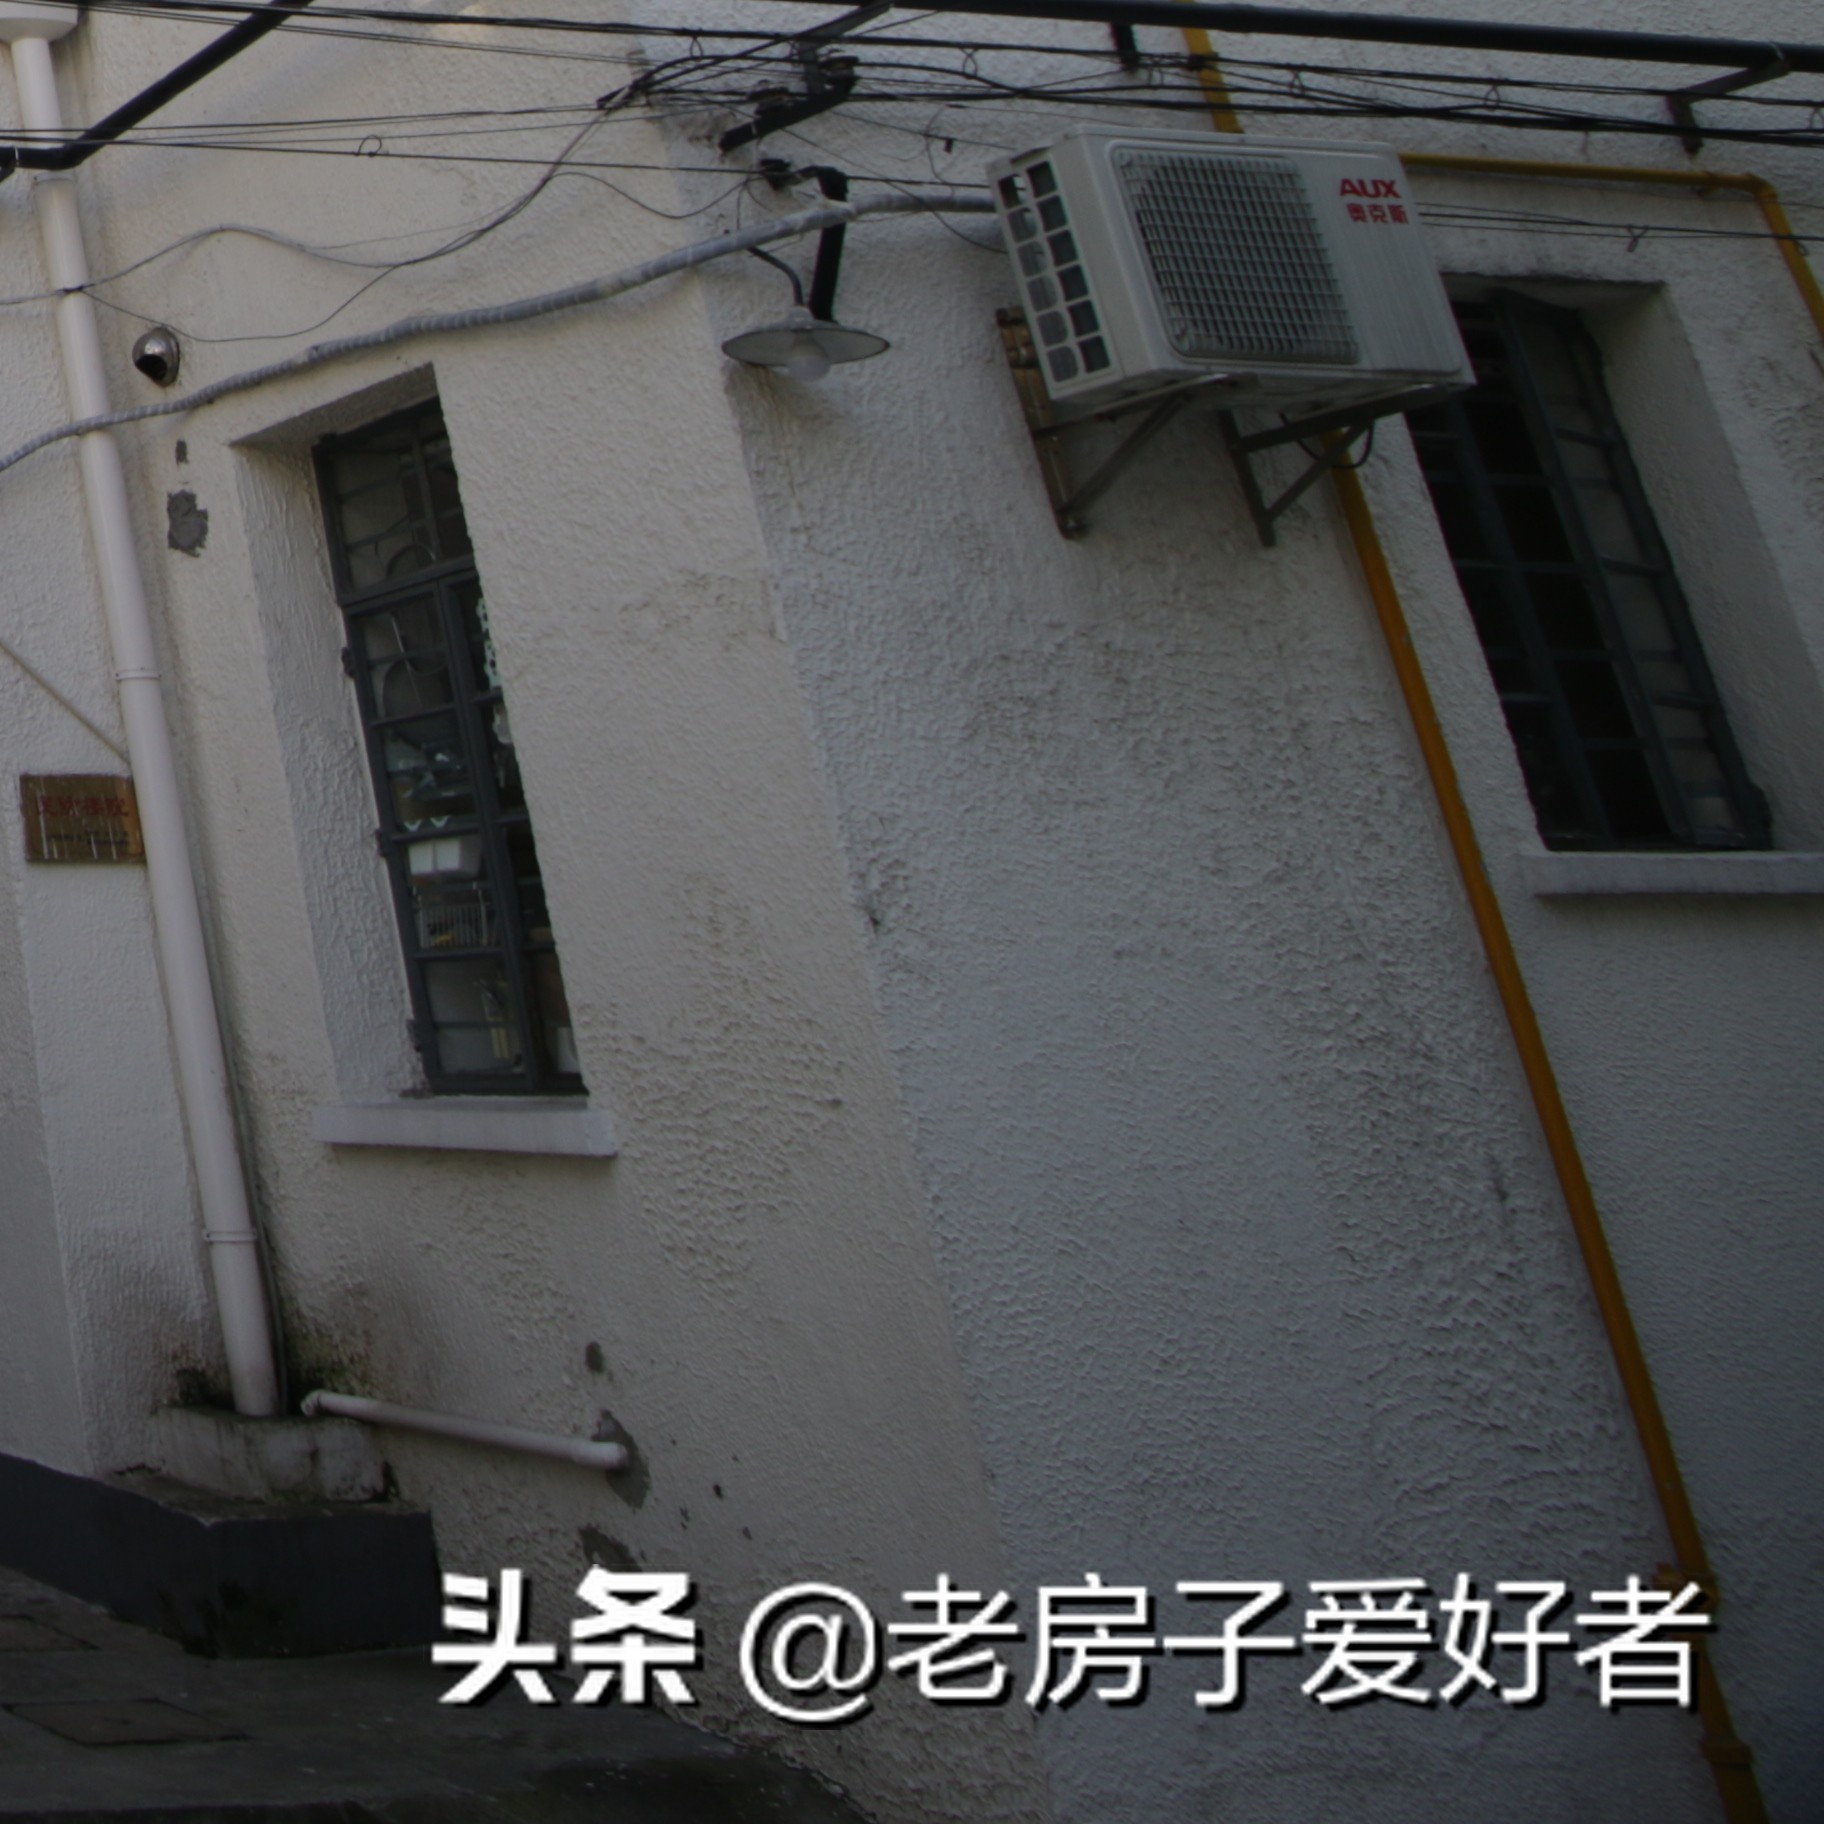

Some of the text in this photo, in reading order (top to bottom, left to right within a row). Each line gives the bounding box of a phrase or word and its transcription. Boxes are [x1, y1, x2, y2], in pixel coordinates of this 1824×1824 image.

[1339, 178, 1401, 199] AUX
[1347, 203, 1408, 224] 奥克斯
